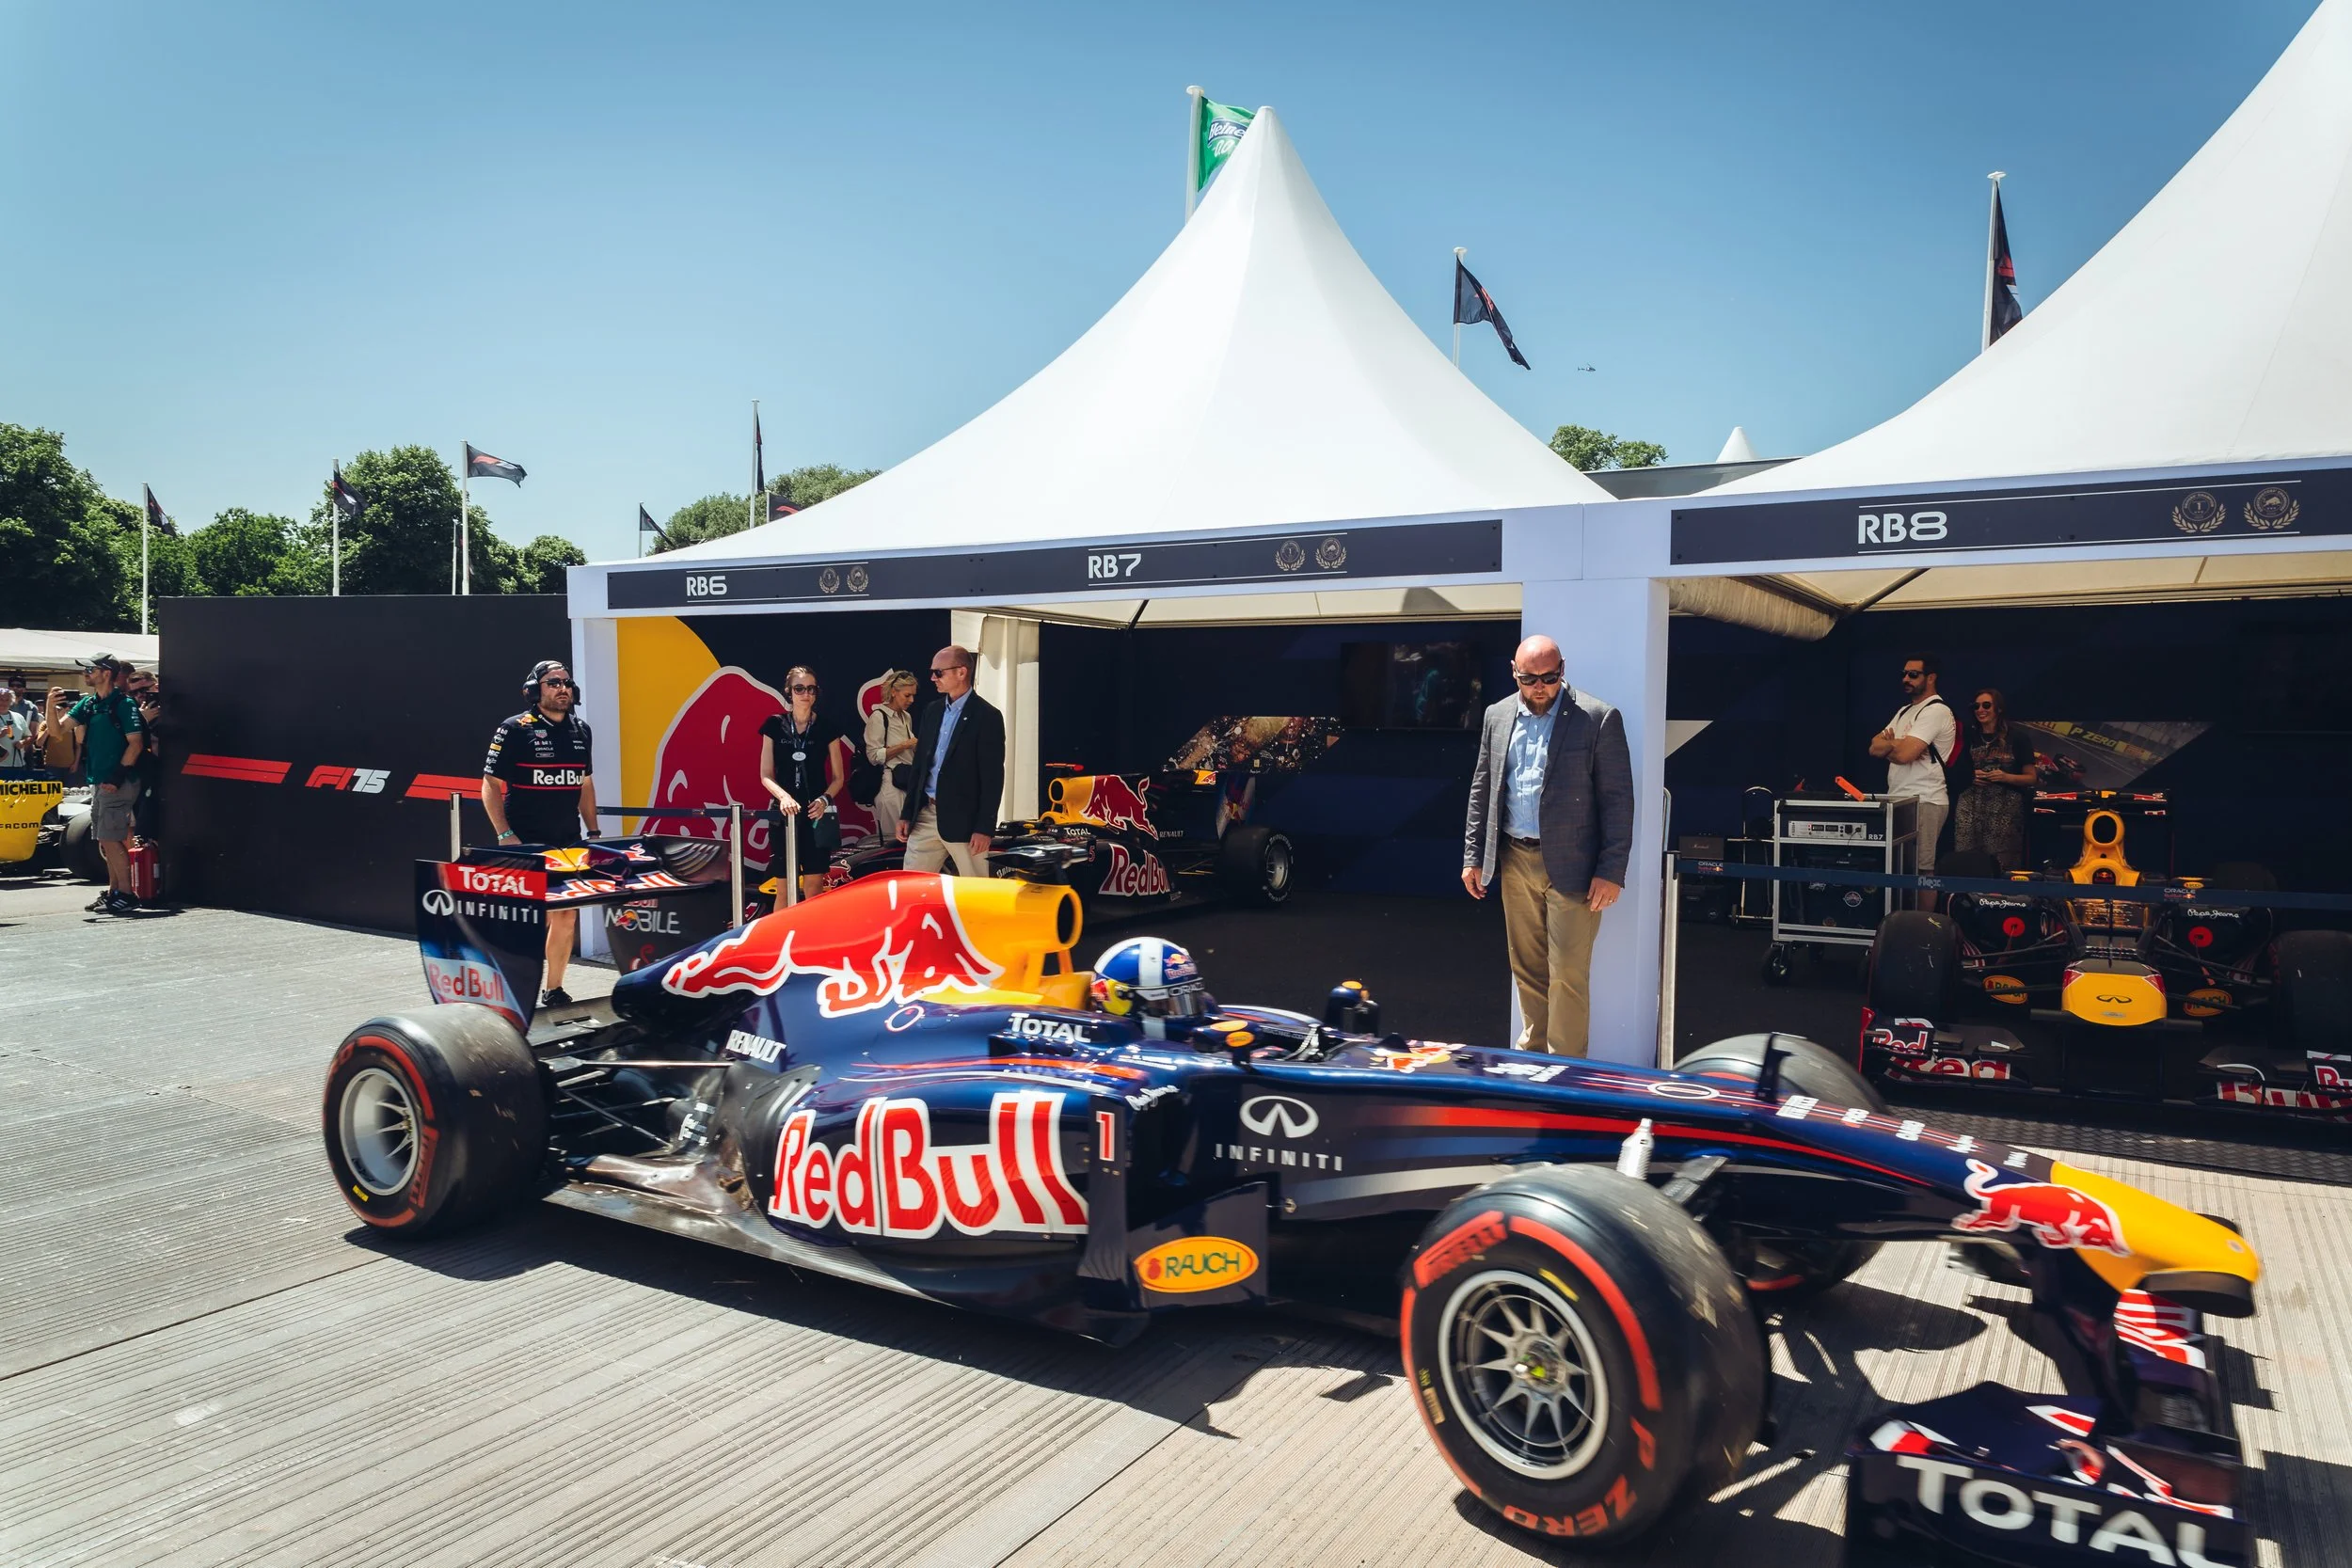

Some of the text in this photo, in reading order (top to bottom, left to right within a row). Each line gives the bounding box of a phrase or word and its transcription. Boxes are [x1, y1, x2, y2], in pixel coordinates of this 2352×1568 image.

[1209, 122, 1246, 140] Heine
[1857, 511, 1948, 544] RB8
[1089, 554, 1142, 578] RB7
[687, 576, 728, 596] RB6
[2082, 731, 2118, 748] ZERO
[533, 769, 585, 785] Red Bul
[1064, 827, 1091, 836] TOTAL
[1159, 830, 1184, 838] RENAULT
[458, 865, 533, 896] TOTAL
[1099, 844, 1150, 896] Red
[457, 899, 538, 924] INFINITI
[605, 907, 681, 935] MOBILE
[2187, 908, 2240, 919] Pepe Jeans
[429, 962, 505, 1002] Red Bull
[1010, 1012, 1091, 1043] TOTAL
[725, 1029, 787, 1064] RENAULT
[1097, 1111, 1115, 1162] 1
[770, 1091, 1089, 1239] Red Bull
[1216, 1144, 1343, 1171] INFINITI
[1165, 1251, 1241, 1278] RAUCH
[1503, 1474, 1637, 1537] ZERO
[1897, 1454, 2238, 1568] TOTAL
